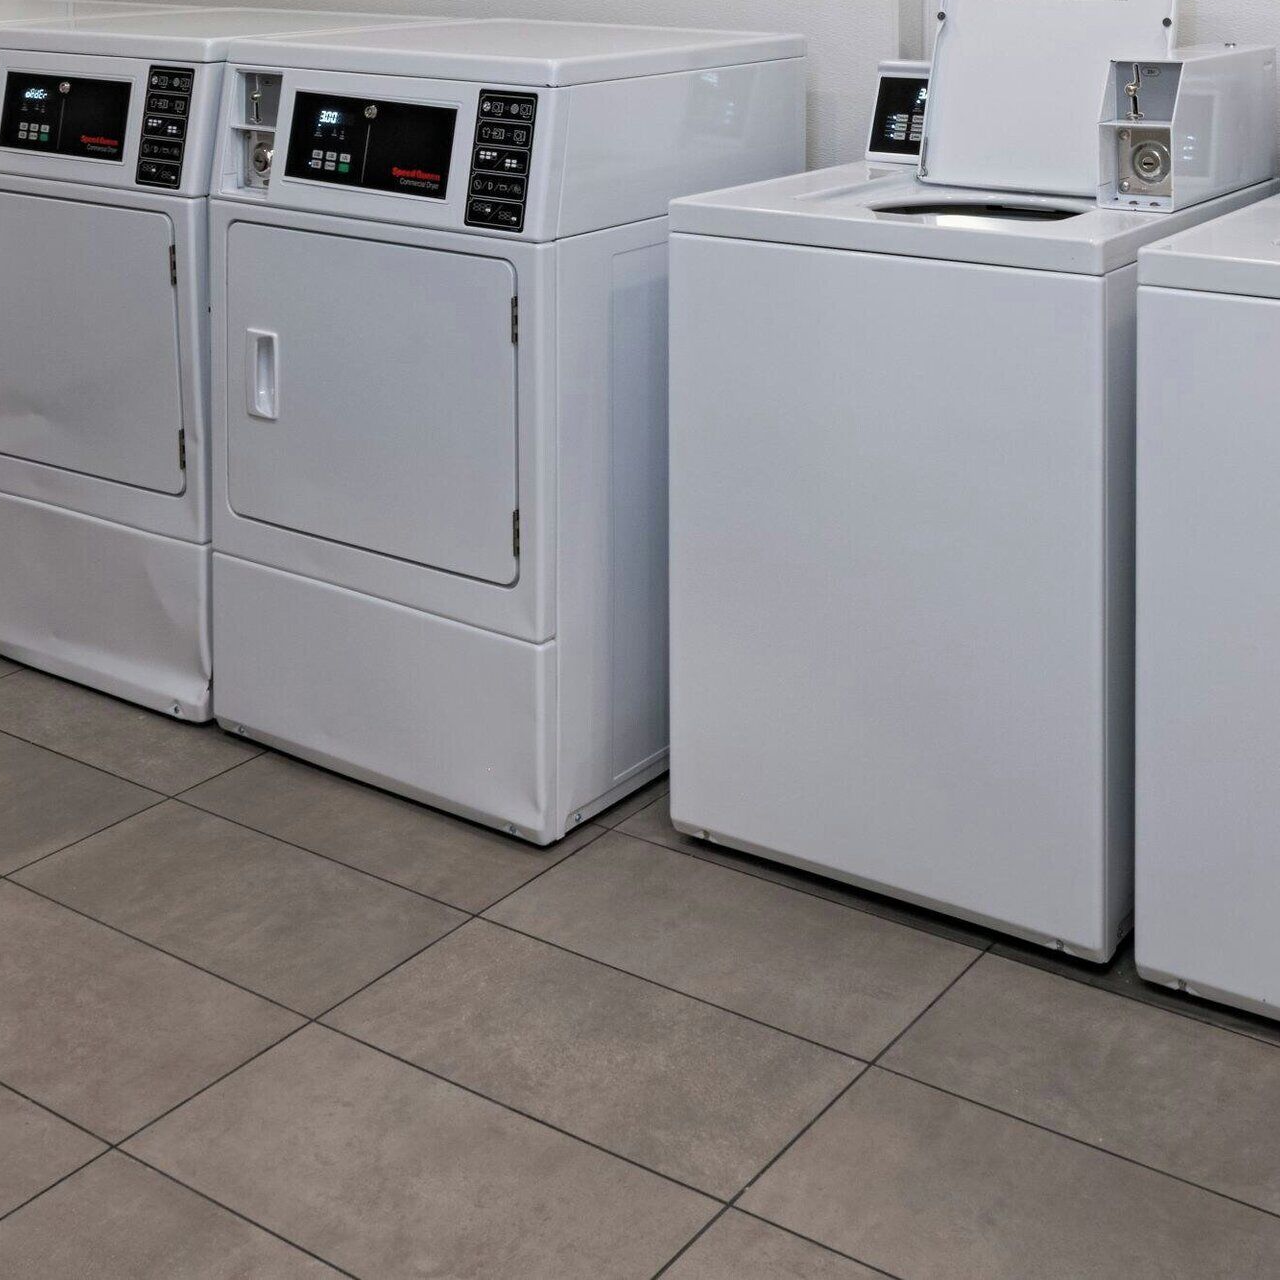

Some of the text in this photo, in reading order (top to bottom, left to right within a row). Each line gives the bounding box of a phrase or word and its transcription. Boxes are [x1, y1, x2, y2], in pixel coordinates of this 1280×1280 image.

[391, 166, 441, 182] Speed Queen
[400, 177, 440, 191] Commercial Dryer
